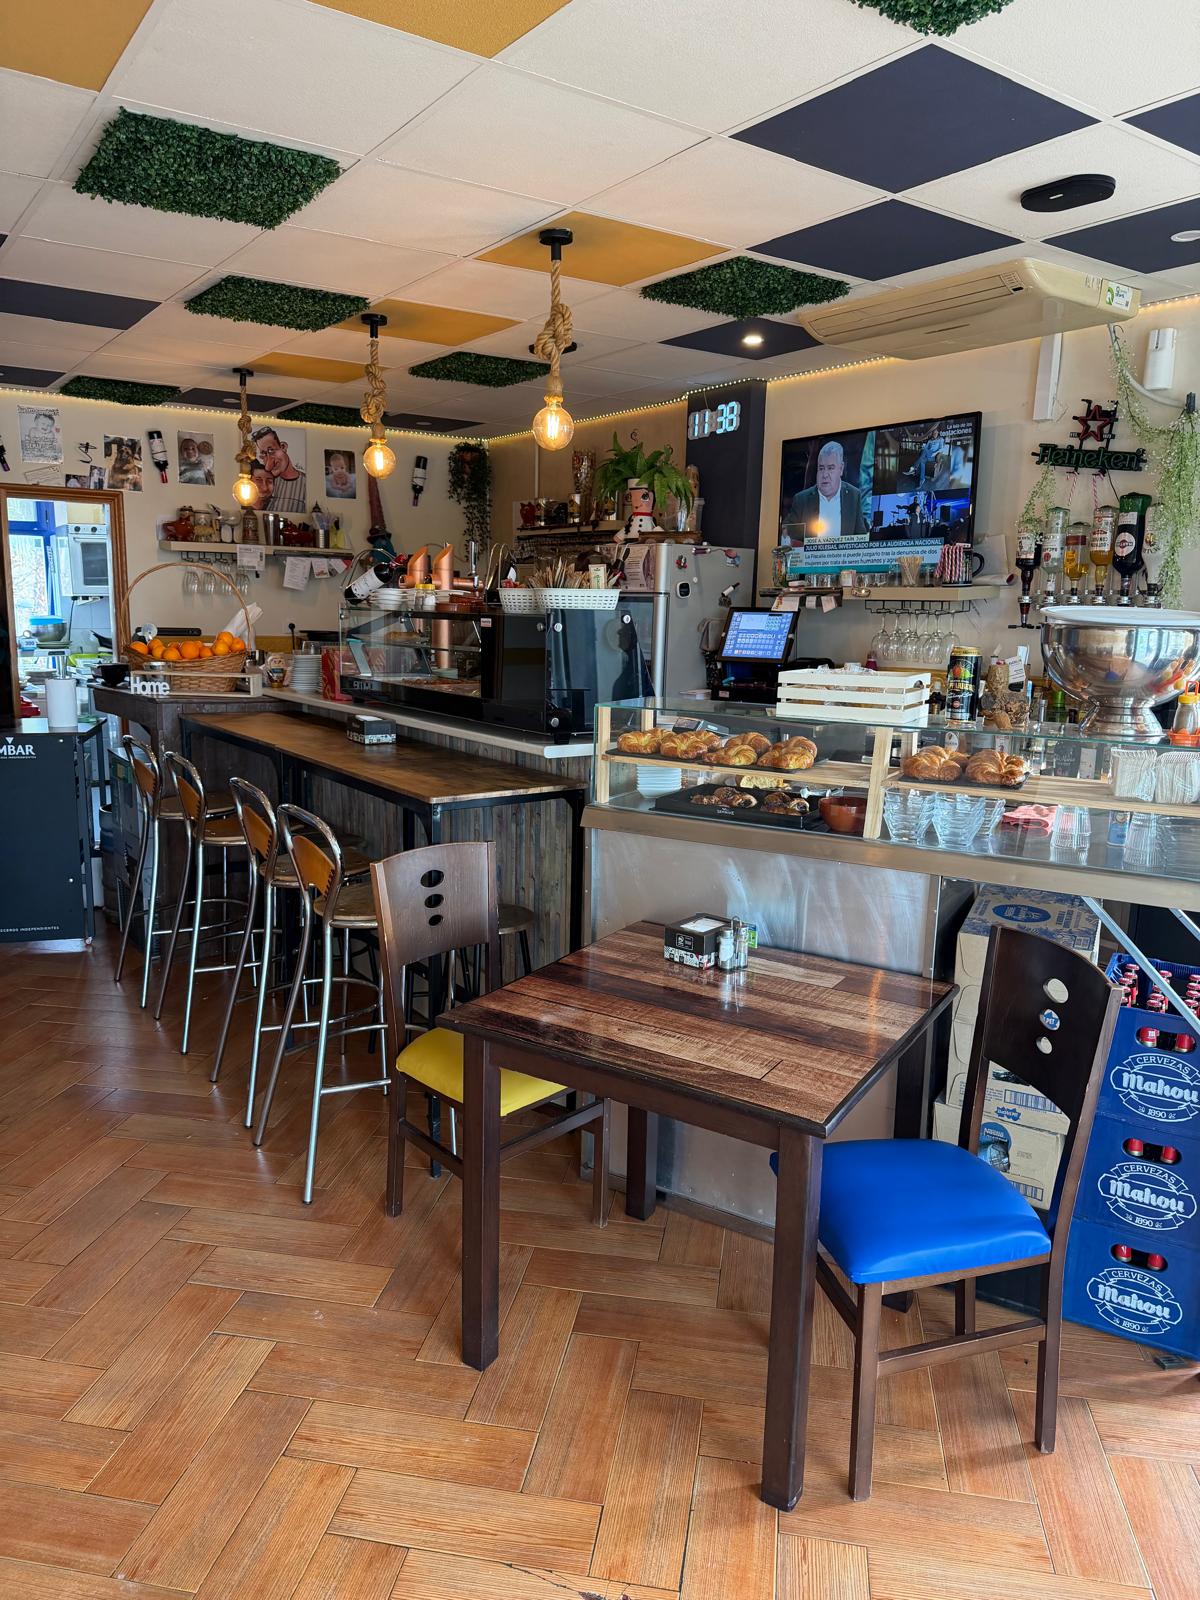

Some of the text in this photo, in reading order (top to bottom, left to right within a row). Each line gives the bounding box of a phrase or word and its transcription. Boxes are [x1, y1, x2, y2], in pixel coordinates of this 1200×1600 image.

[1036, 444, 1143, 471] Heineken
[839, 542, 868, 550] INVESTIGADO
[914, 538, 942, 546] NACIONAL
[130, 676, 170, 696] Home
[1136, 1055, 1191, 1074] CERVEZAS
[1122, 1071, 1199, 1103] Mahou
[1147, 1108, 1167, 1119] 1890
[1123, 1164, 1176, 1184] CERVEZAS
[1109, 1180, 1185, 1213] Mahou
[1135, 1217, 1153, 1228] 1890
[1111, 1270, 1163, 1291] CERVEZAS
[1097, 1283, 1171, 1319] Mahou
[1122, 1319, 1141, 1332] 1890
